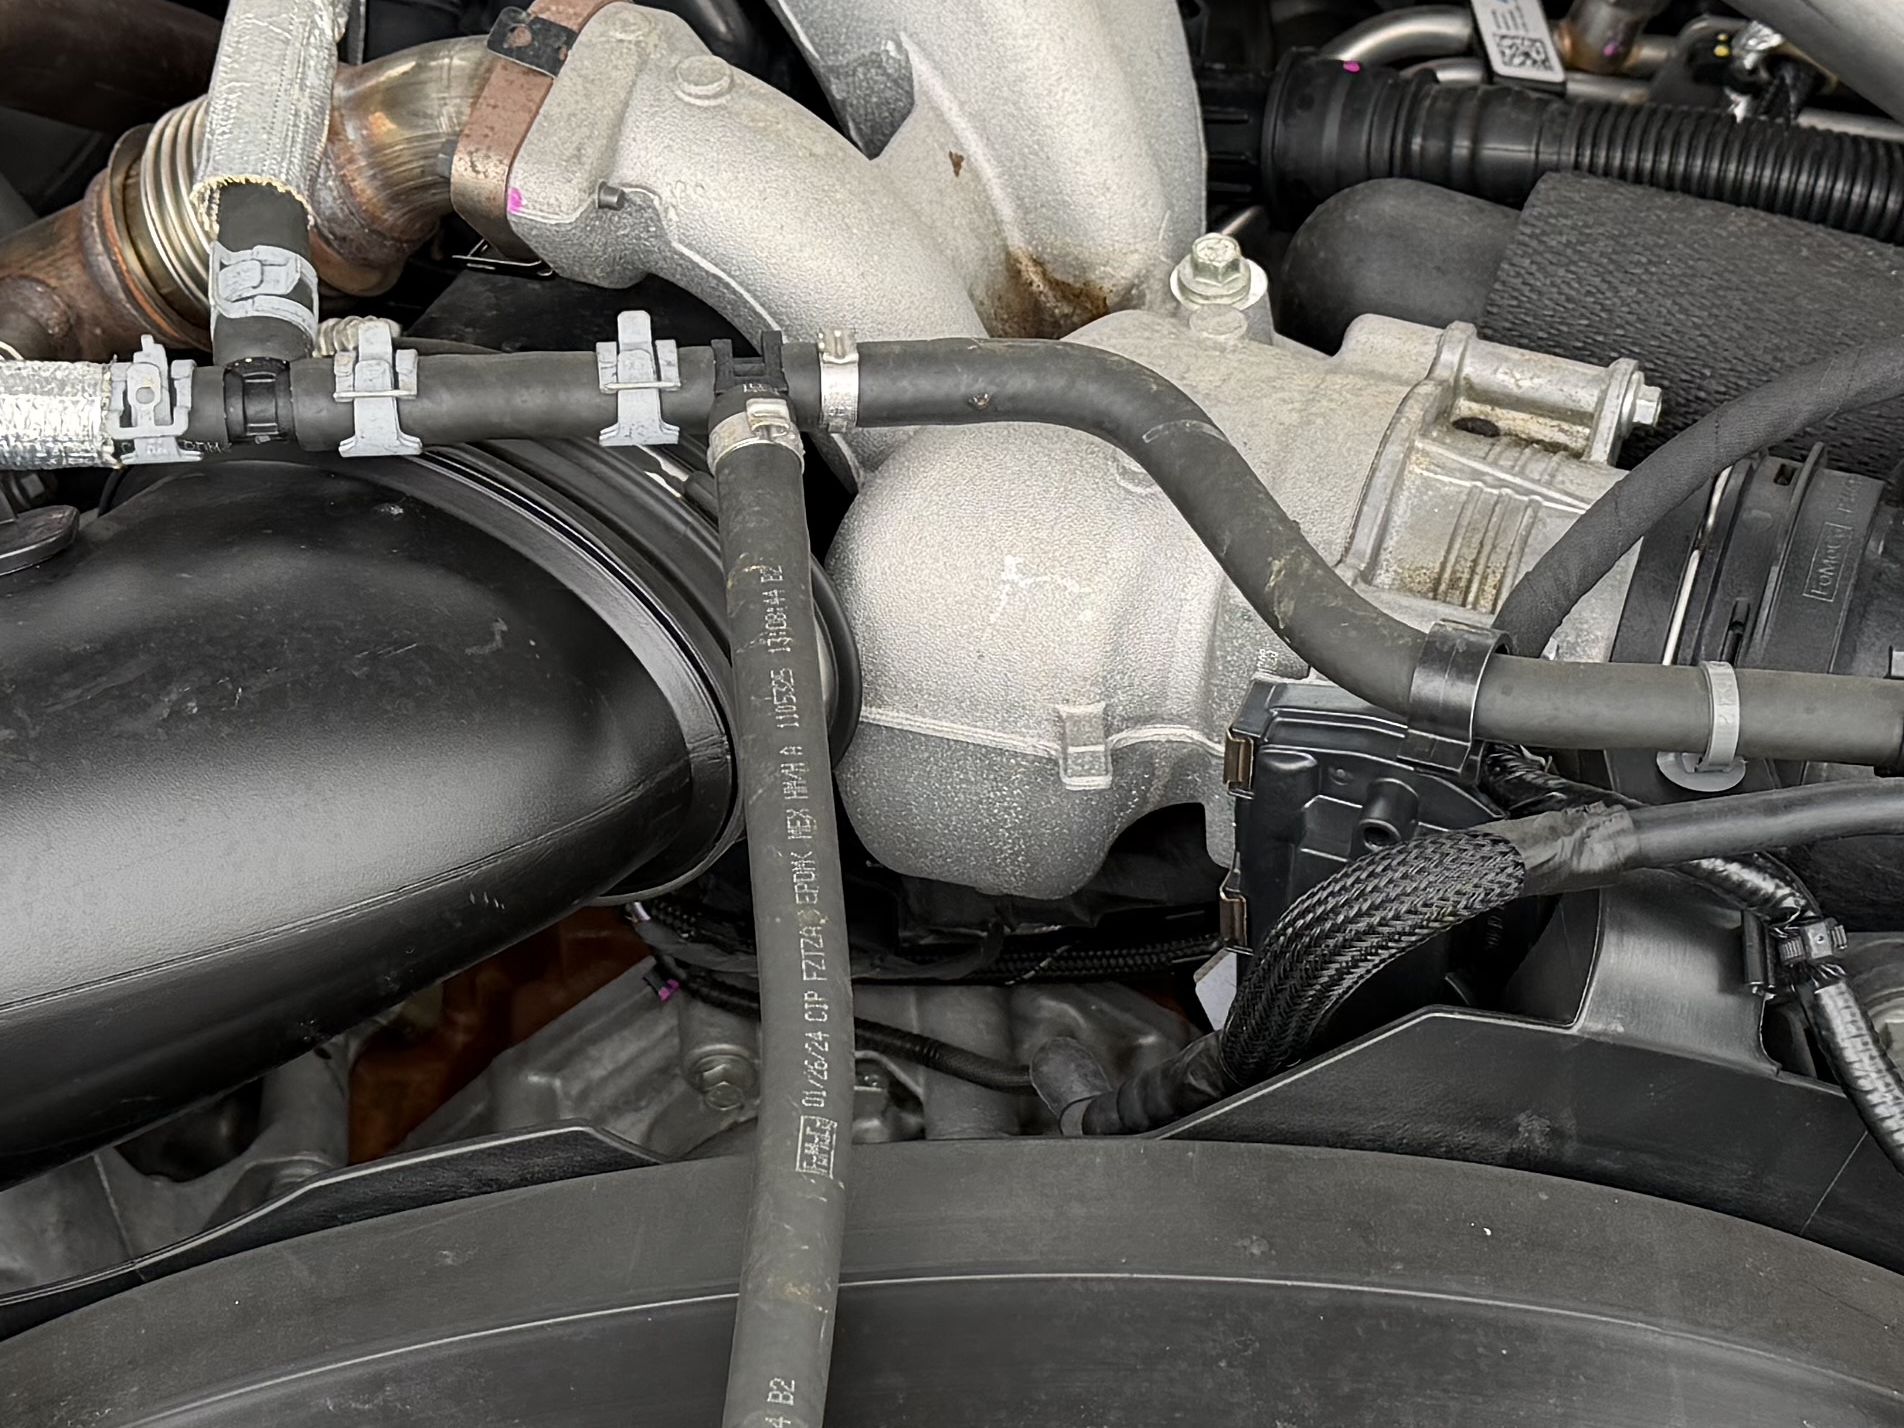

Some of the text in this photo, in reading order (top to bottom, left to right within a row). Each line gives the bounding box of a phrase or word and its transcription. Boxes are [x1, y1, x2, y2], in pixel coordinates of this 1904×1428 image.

[770, 667, 799, 728] 1105325
[801, 1030, 829, 1107] 01/26/24
[767, 1377, 796, 1406] B2
